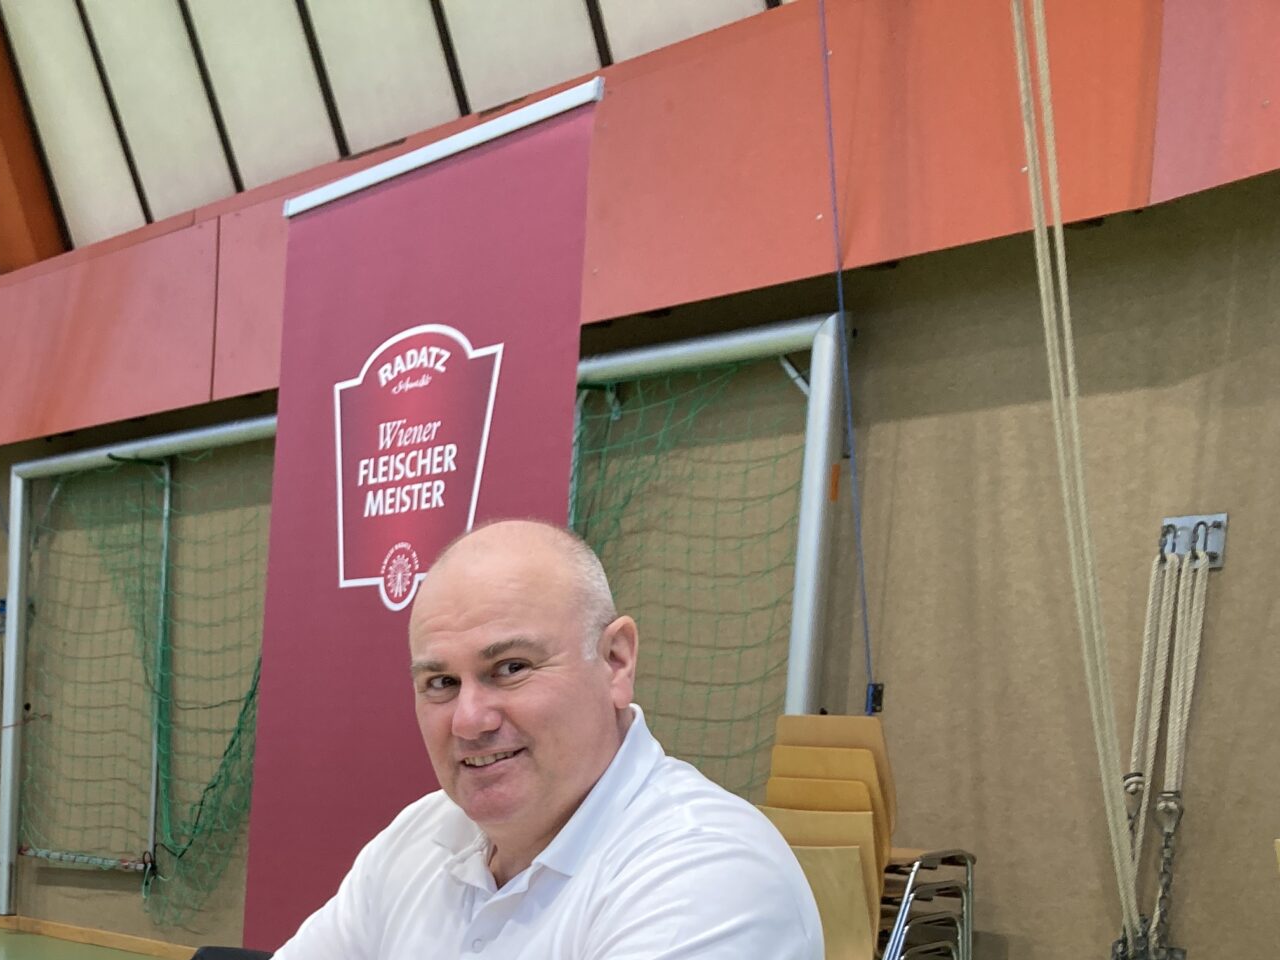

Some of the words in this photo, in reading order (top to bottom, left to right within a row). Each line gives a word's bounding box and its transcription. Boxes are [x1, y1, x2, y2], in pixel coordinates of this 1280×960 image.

[378, 346, 451, 387] RADATZ
[379, 418, 441, 450] Wiener
[357, 444, 457, 487] FLEISCHER
[363, 480, 445, 517] MEISTER
